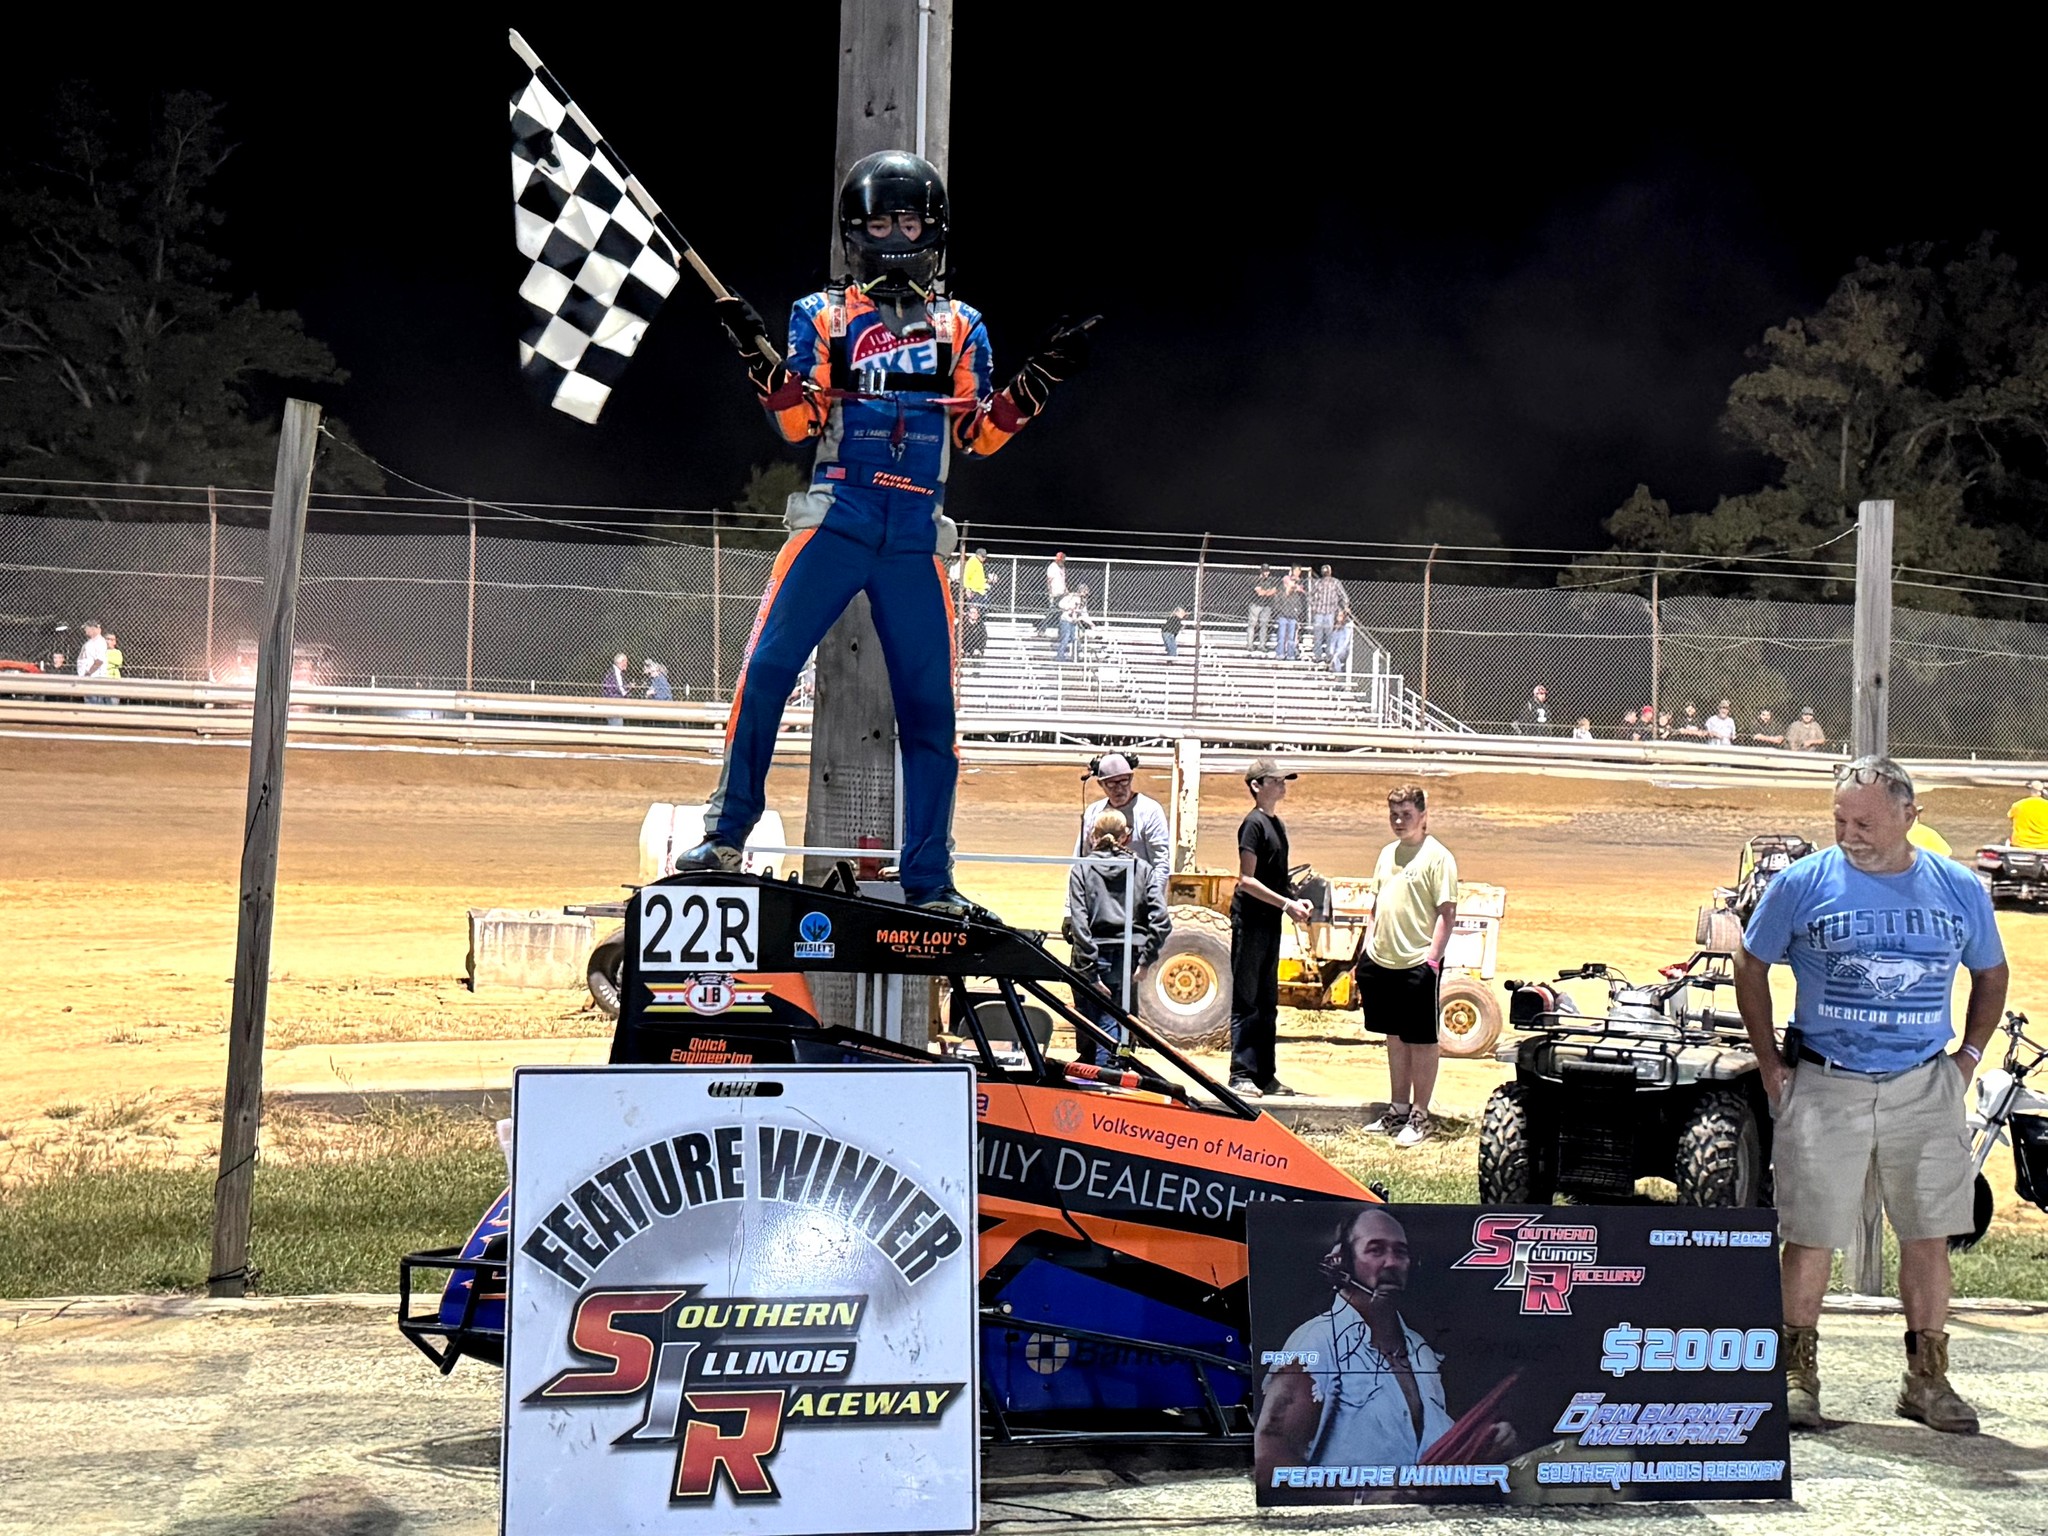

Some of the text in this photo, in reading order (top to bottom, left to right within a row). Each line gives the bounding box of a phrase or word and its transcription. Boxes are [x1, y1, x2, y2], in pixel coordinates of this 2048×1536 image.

[642, 894, 754, 963] 22R
[876, 929, 967, 946] MARY LOU'S
[1807, 908, 1963, 949] MUSTANG
[891, 944, 952, 954] GRILL
[689, 1037, 727, 1052] Quick
[1092, 1112, 1289, 1170] Volkswagen of Marion
[521, 1125, 963, 1292] FEATURE WINNER
[1261, 1351, 1320, 1365] PAY TO
[1600, 1322, 1778, 1378] $2000
[1553, 1403, 1772, 1432] DAN BURNETT
[1579, 1424, 1749, 1445] MEMORIAL
[1271, 1465, 1512, 1493] FEATURE WINNER
[1537, 1461, 1785, 1490] SOUTHERN ILLINOIS RACEWAY
